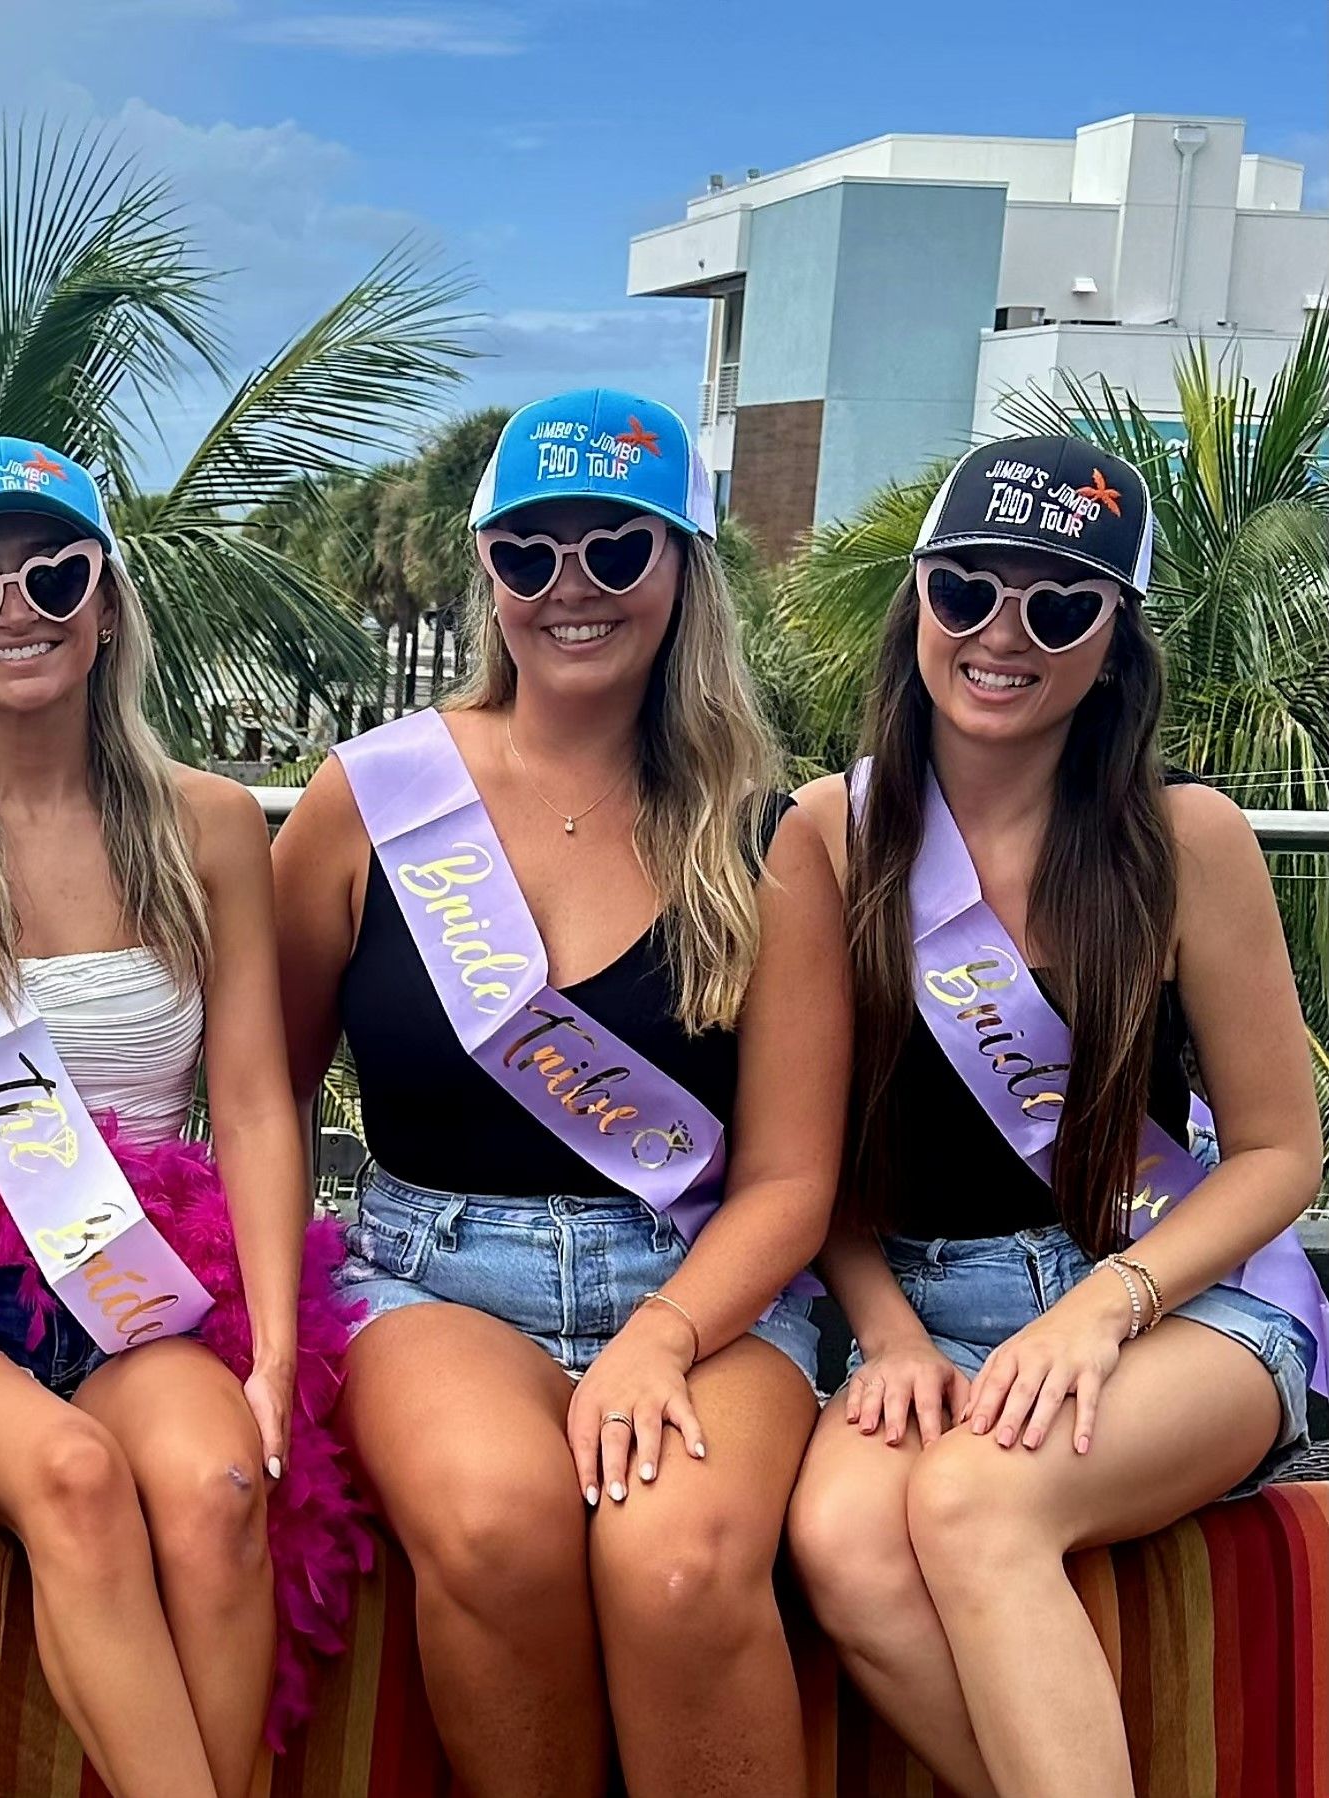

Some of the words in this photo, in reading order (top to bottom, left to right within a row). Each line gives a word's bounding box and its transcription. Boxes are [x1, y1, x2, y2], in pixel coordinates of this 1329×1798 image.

[529, 421, 589, 442] JIMBO'S
[537, 442, 579, 481] FOOD
[585, 452, 629, 481] TOUR
[985, 459, 1050, 490] JIMBO'S
[984, 482, 1035, 525] FOOD
[1039, 500, 1084, 539] TOUR
[397, 840, 530, 1017] Bride
[501, 1002, 635, 1137] Tribe
